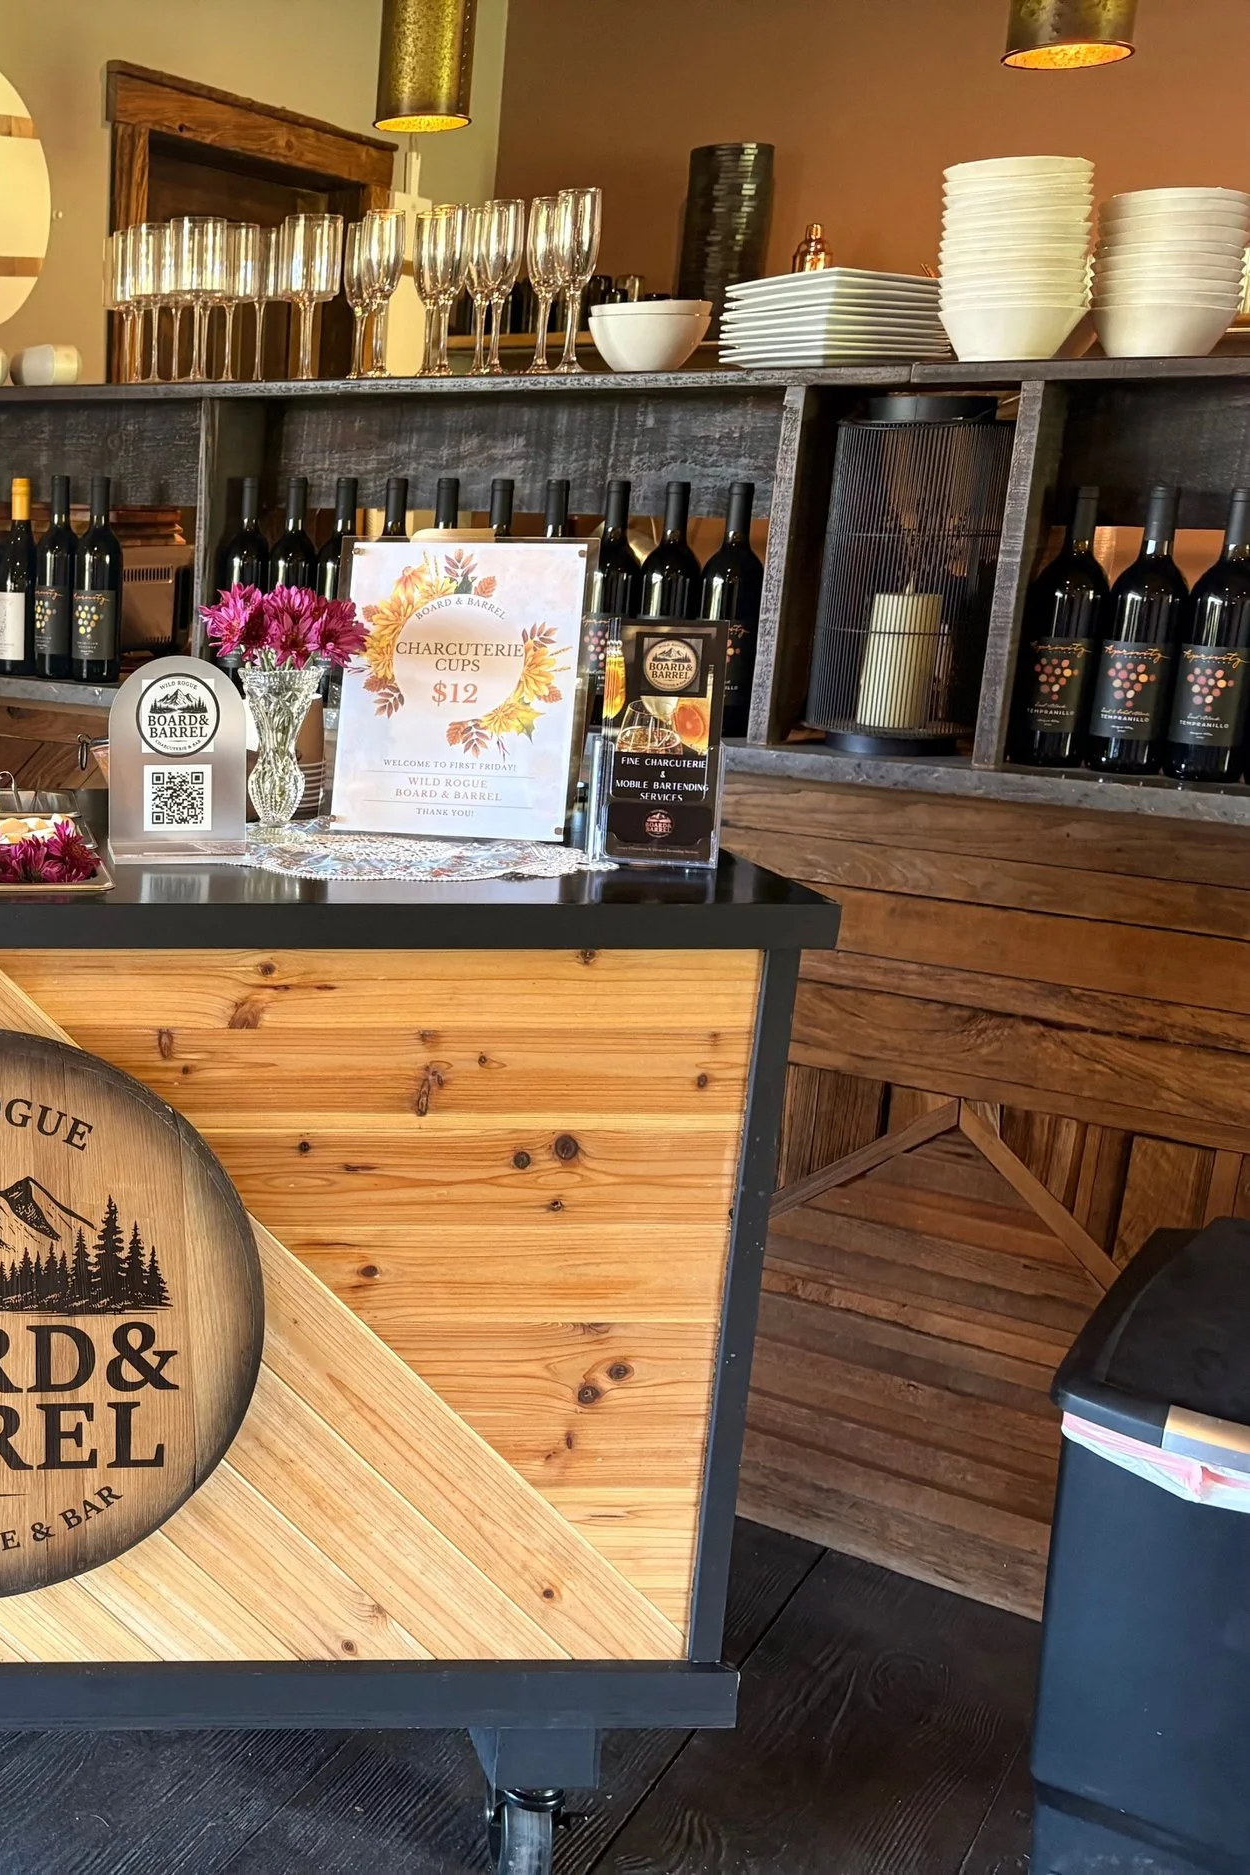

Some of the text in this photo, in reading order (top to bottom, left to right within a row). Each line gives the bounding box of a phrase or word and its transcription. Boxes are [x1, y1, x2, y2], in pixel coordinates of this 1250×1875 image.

[415, 597, 506, 620] BOARD & BARREL
[396, 641, 524, 657] CHARCUTERIE
[435, 658, 480, 672] CUPS
[651, 670, 691, 680] BARREL
[159, 680, 198, 690] WILD ROGUE
[432, 680, 478, 707] $12
[148, 714, 209, 726] BOARD&
[1101, 714, 1150, 723] TEMPRANILLO
[1179, 720, 1229, 729] TEMPRANILLO
[149, 726, 208, 738] BARREL
[383, 759, 517, 772] WELCOME TO FIRST FRIDAY!
[621, 756, 707, 769] FINE CHARCUTERIE
[659, 770, 666, 779] &
[408, 777, 488, 789] WILD ROGUE
[615, 779, 710, 792] MOBILE BARTENDING
[395, 788, 502, 801] BOARD & BARREL
[639, 792, 684, 802] SERVICES
[416, 807, 474, 817] THANK YOU!
[31, 1521, 55, 1543] &
[61, 1484, 124, 1531] BAR
